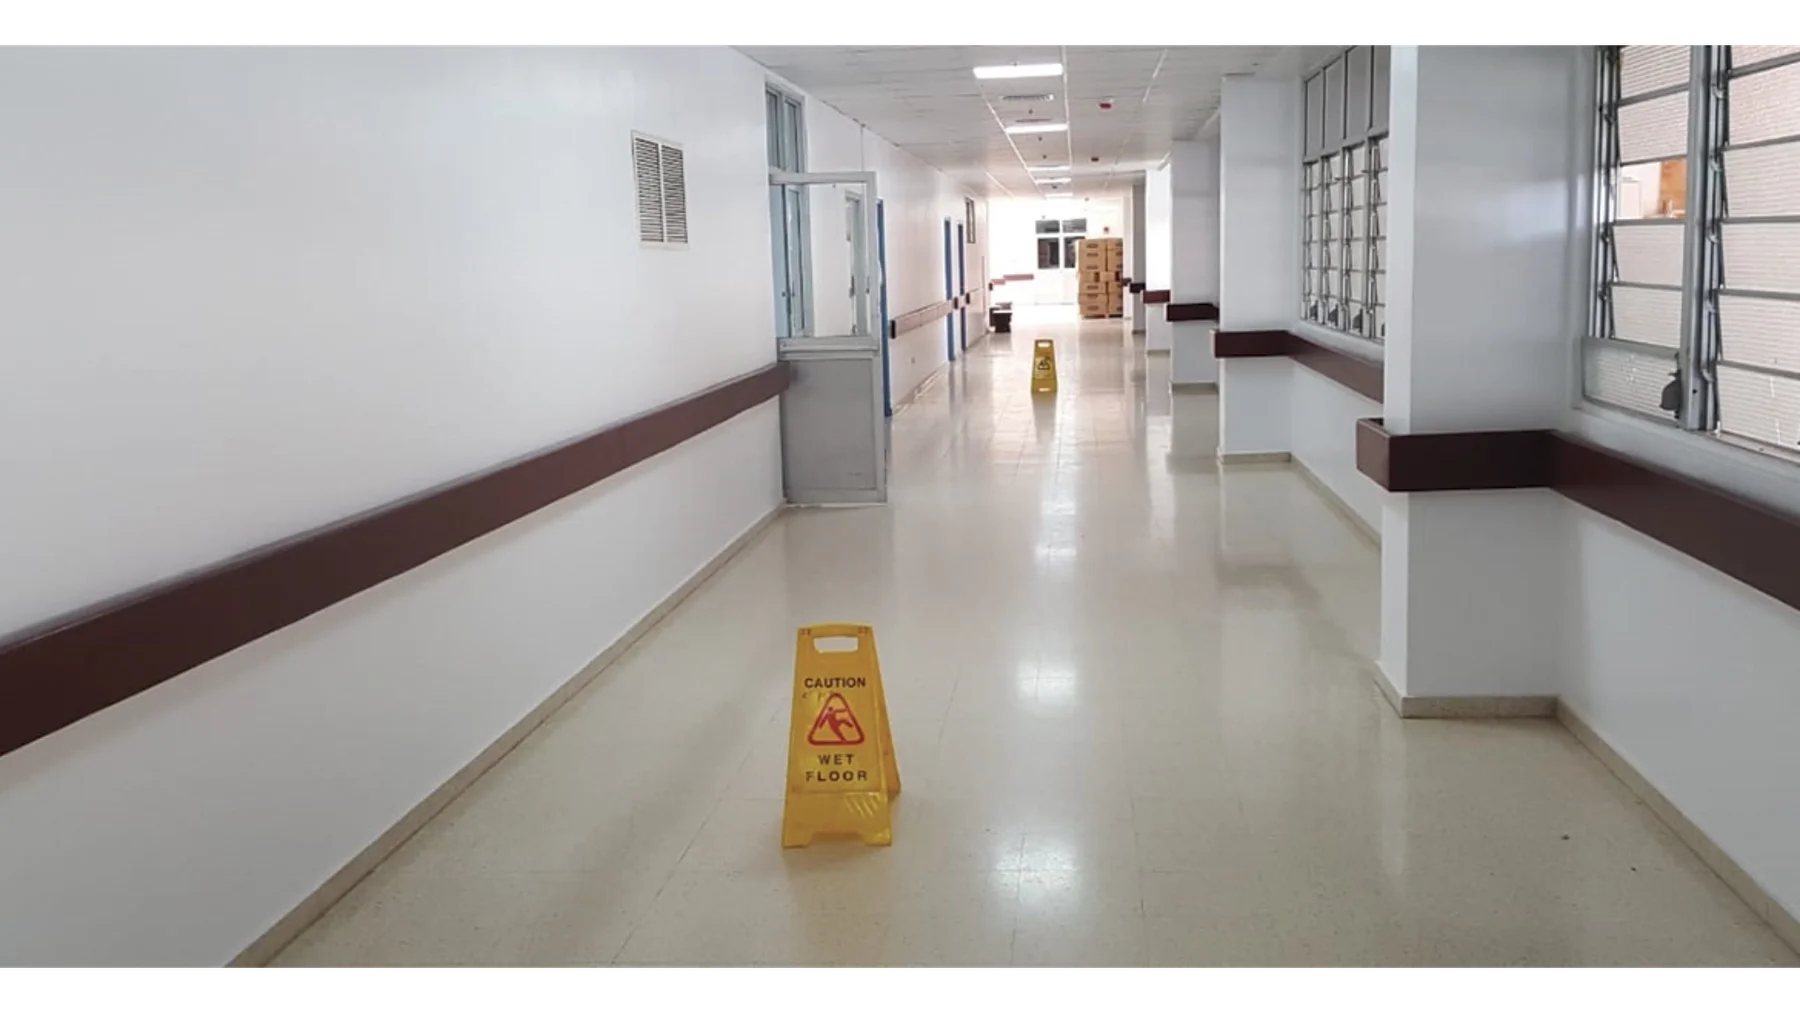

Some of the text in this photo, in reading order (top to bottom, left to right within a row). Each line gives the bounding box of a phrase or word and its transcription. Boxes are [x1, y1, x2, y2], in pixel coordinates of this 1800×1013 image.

[804, 677, 866, 688] CAUTION
[817, 753, 854, 765] WET
[805, 770, 867, 782] FLOOR
